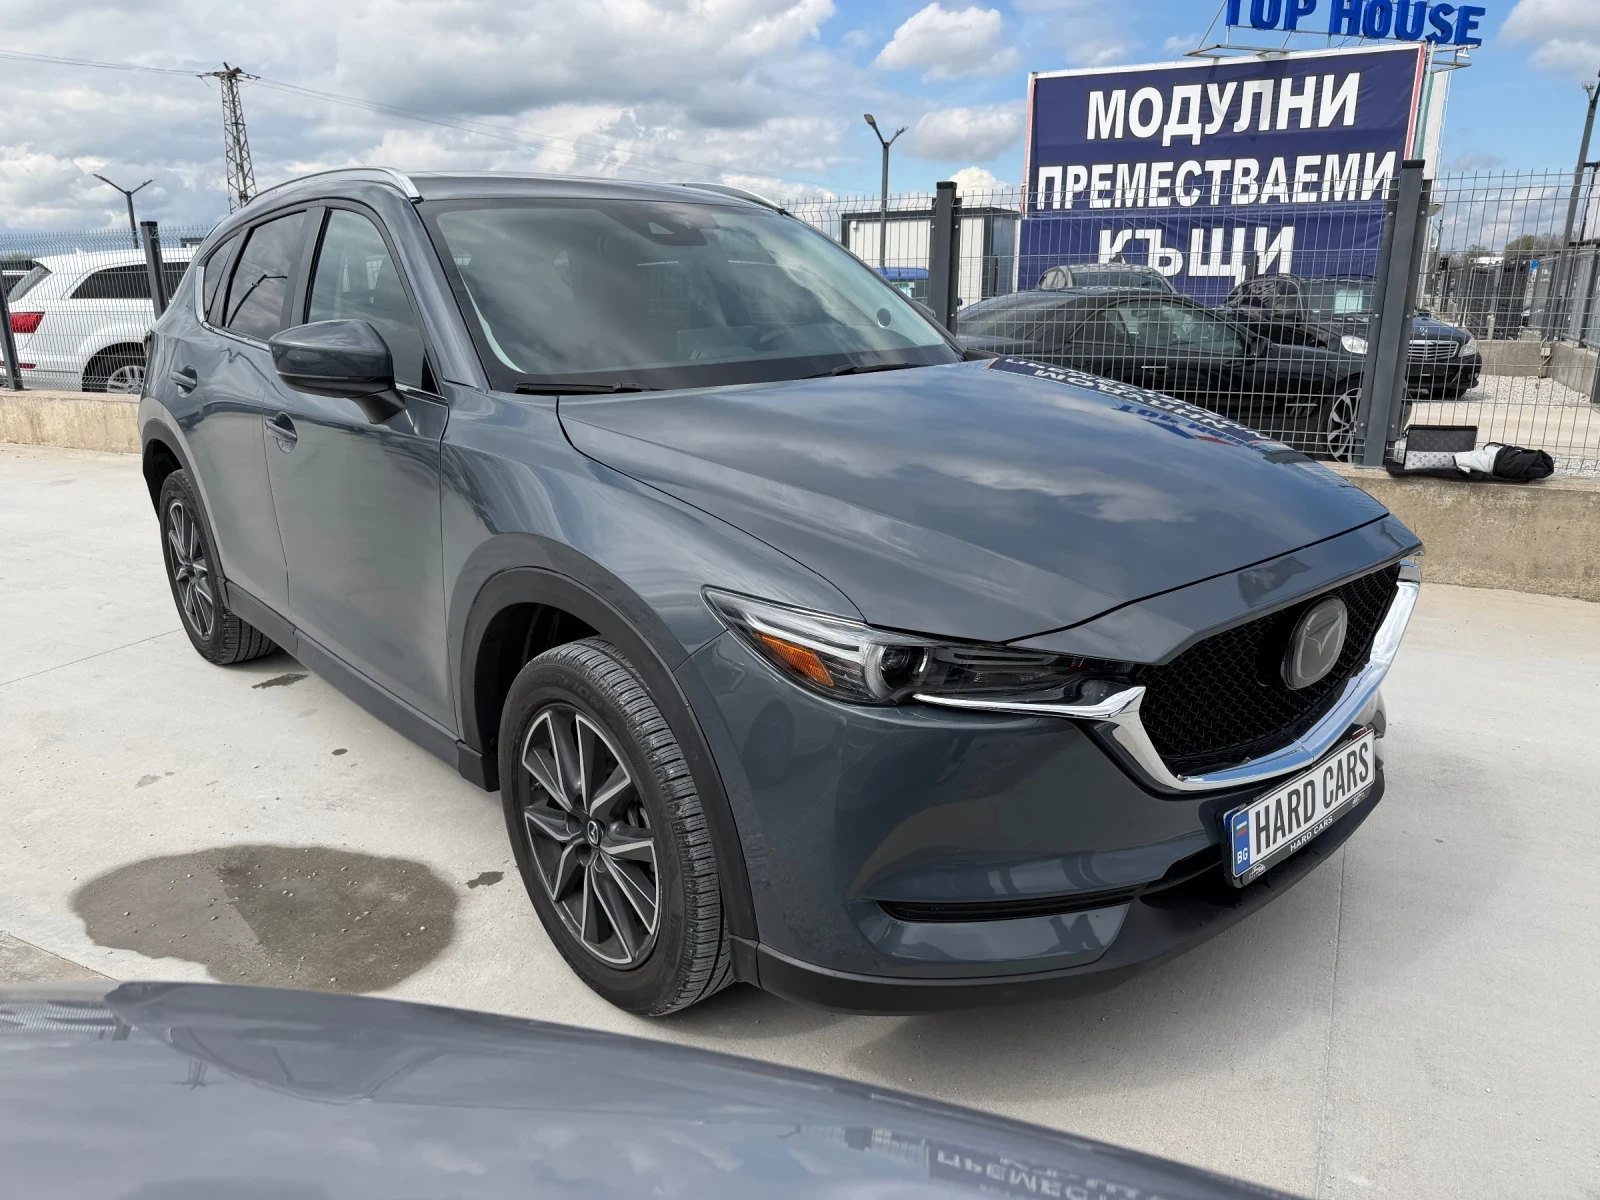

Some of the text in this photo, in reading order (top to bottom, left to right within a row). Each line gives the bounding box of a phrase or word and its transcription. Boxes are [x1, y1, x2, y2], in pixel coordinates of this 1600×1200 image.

[1329, 0, 1486, 45] HOUSE
[1086, 73, 1360, 147] МОДУЛНИ
[1037, 152, 1397, 210] ПРЕМЕСТВАЕМИ
[1098, 226, 1295, 286] КЪЩИ
[1255, 741, 1369, 855] HARD CARS
[1237, 847, 1248, 864] BG
[1290, 815, 1333, 852] HARD CARS
